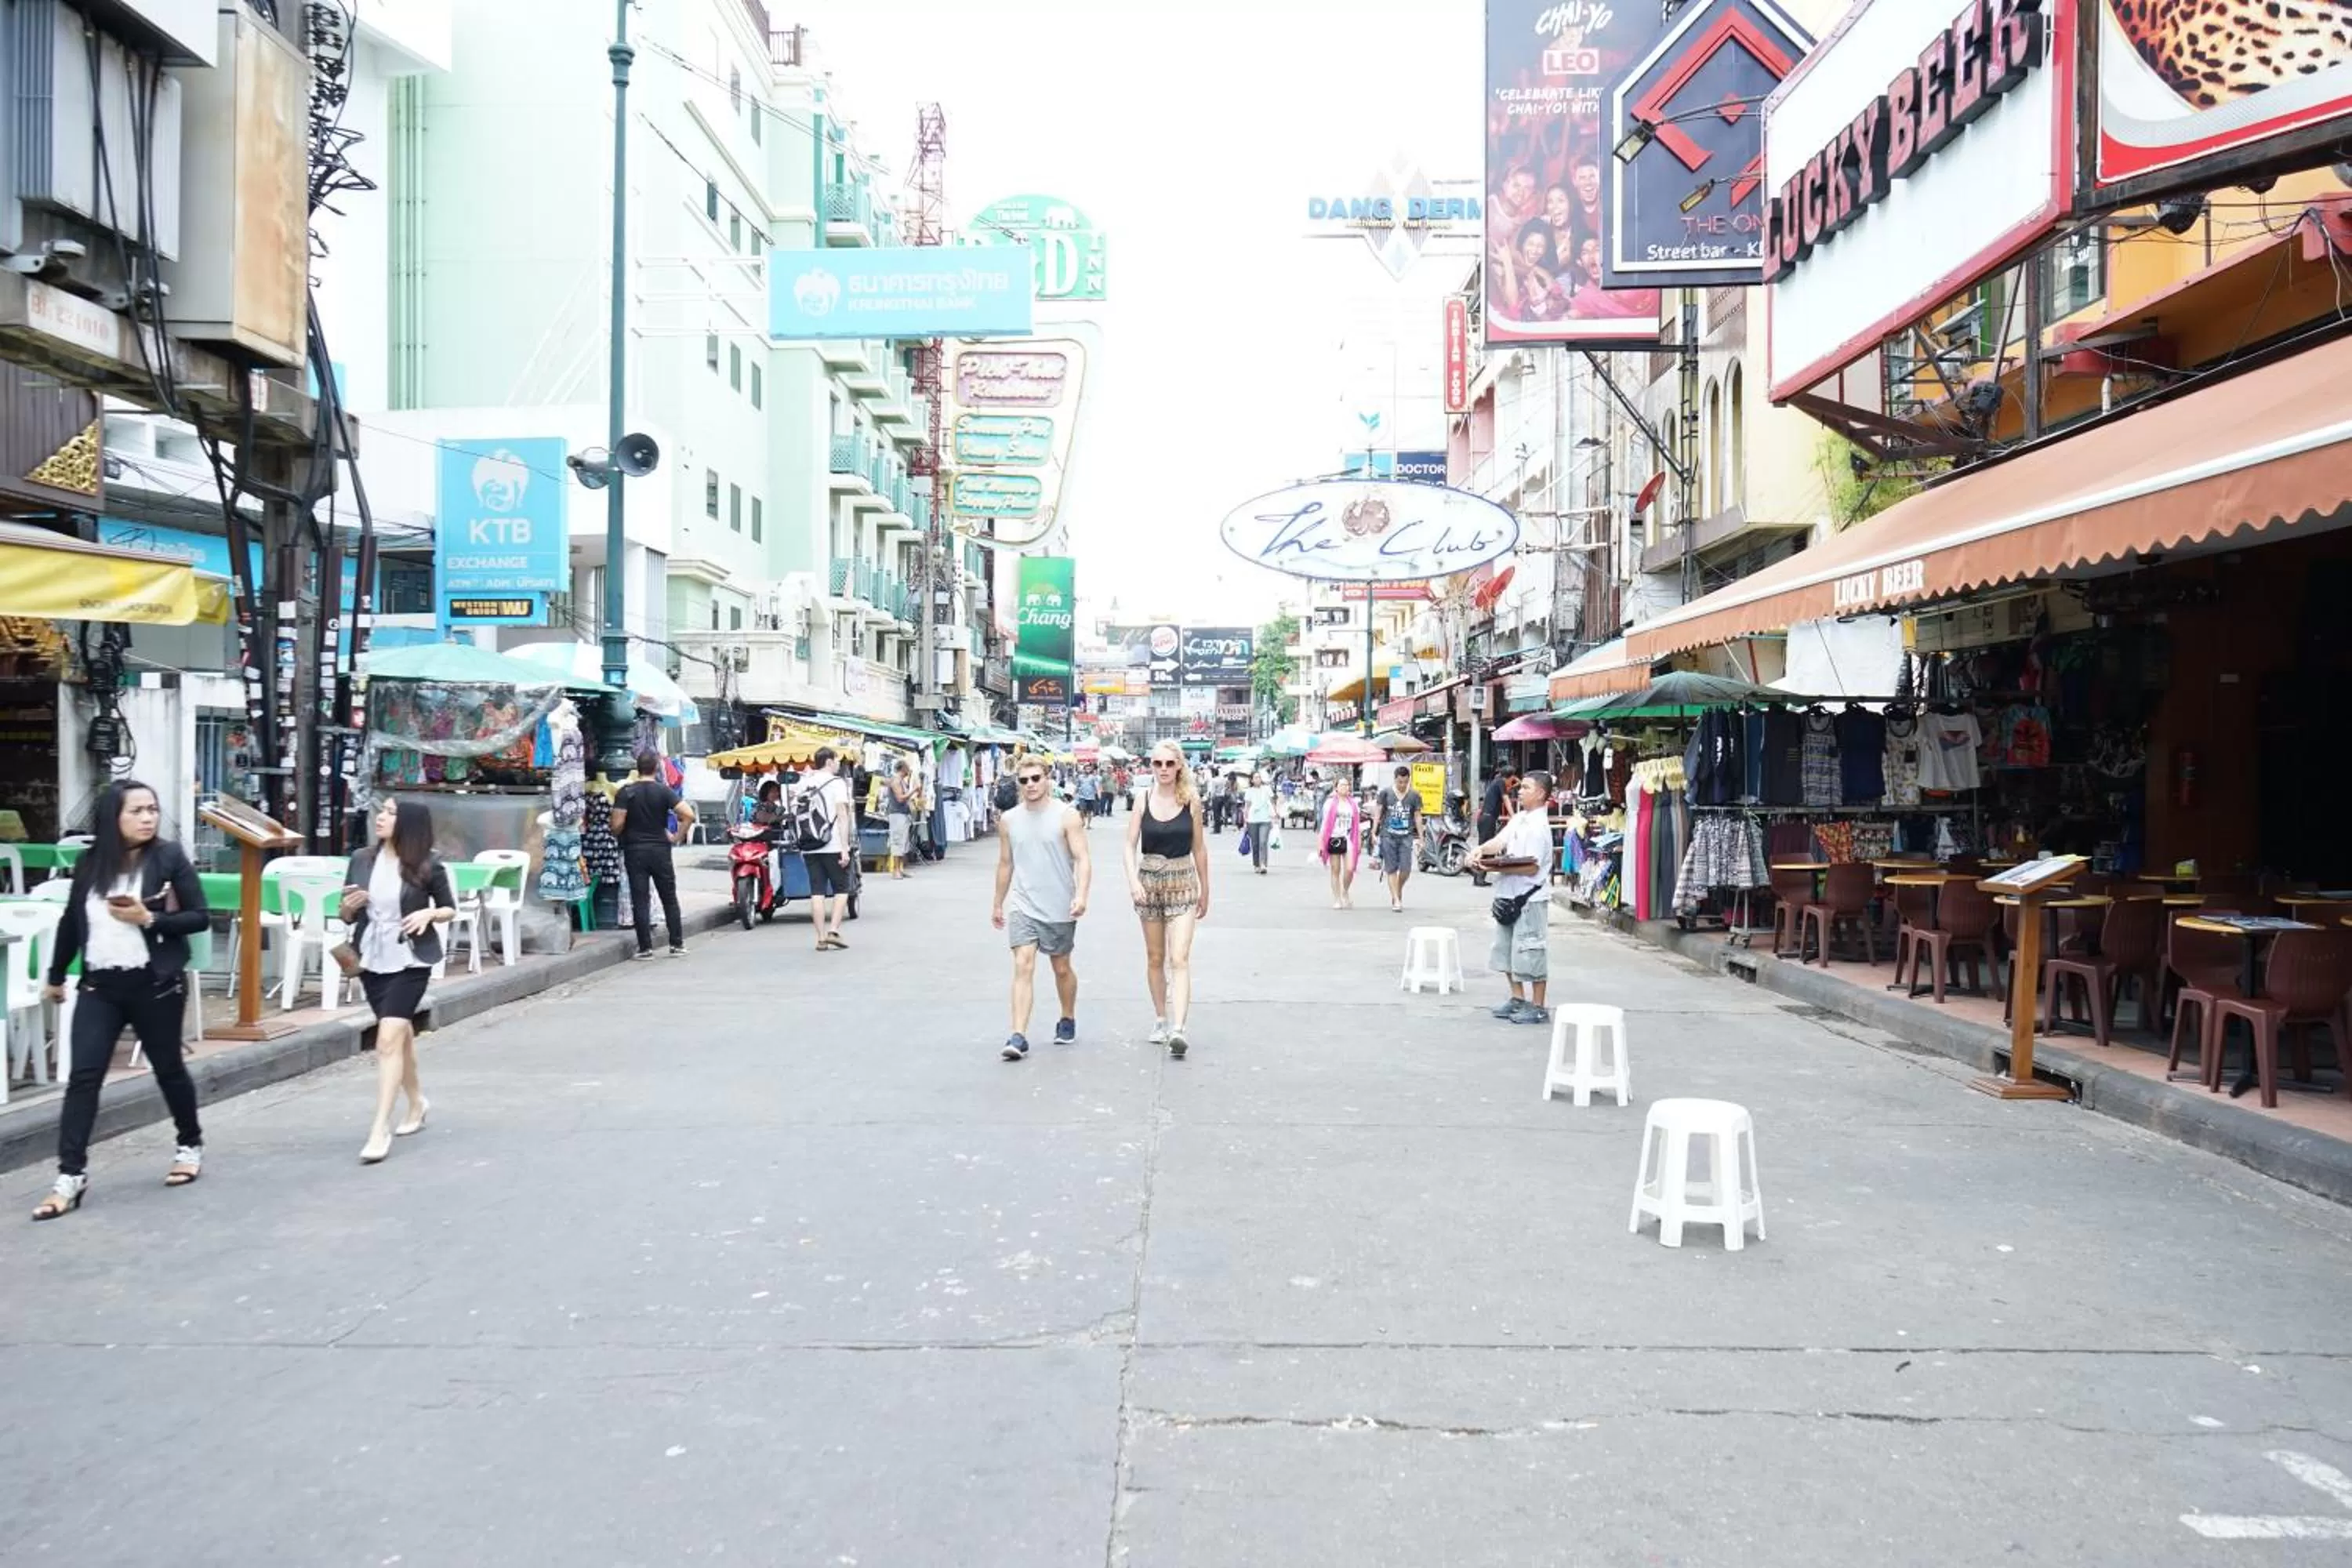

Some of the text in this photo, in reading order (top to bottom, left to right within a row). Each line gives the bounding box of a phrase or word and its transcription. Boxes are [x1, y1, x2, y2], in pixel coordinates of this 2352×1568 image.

[1534, 0, 1613, 36] CHAI-YO
[1546, 52, 1596, 72] LEO
[1578, 87, 1604, 99] LIK
[1762, 0, 2032, 284] LUCKY BEER
[1308, 197, 1393, 220] DANG
[1680, 215, 1726, 235] THE
[1646, 244, 1697, 261] Street
[1700, 241, 1728, 259] bar
[1450, 371, 1461, 405] FOOD
[1396, 463, 1446, 474] DOCTOR
[470, 517, 532, 545] KTB
[1254, 501, 1495, 557] The Club
[446, 556, 528, 569] EXCHANGE
[1834, 559, 1924, 609] LUCKY BEER
[1018, 607, 1072, 630] Chang
